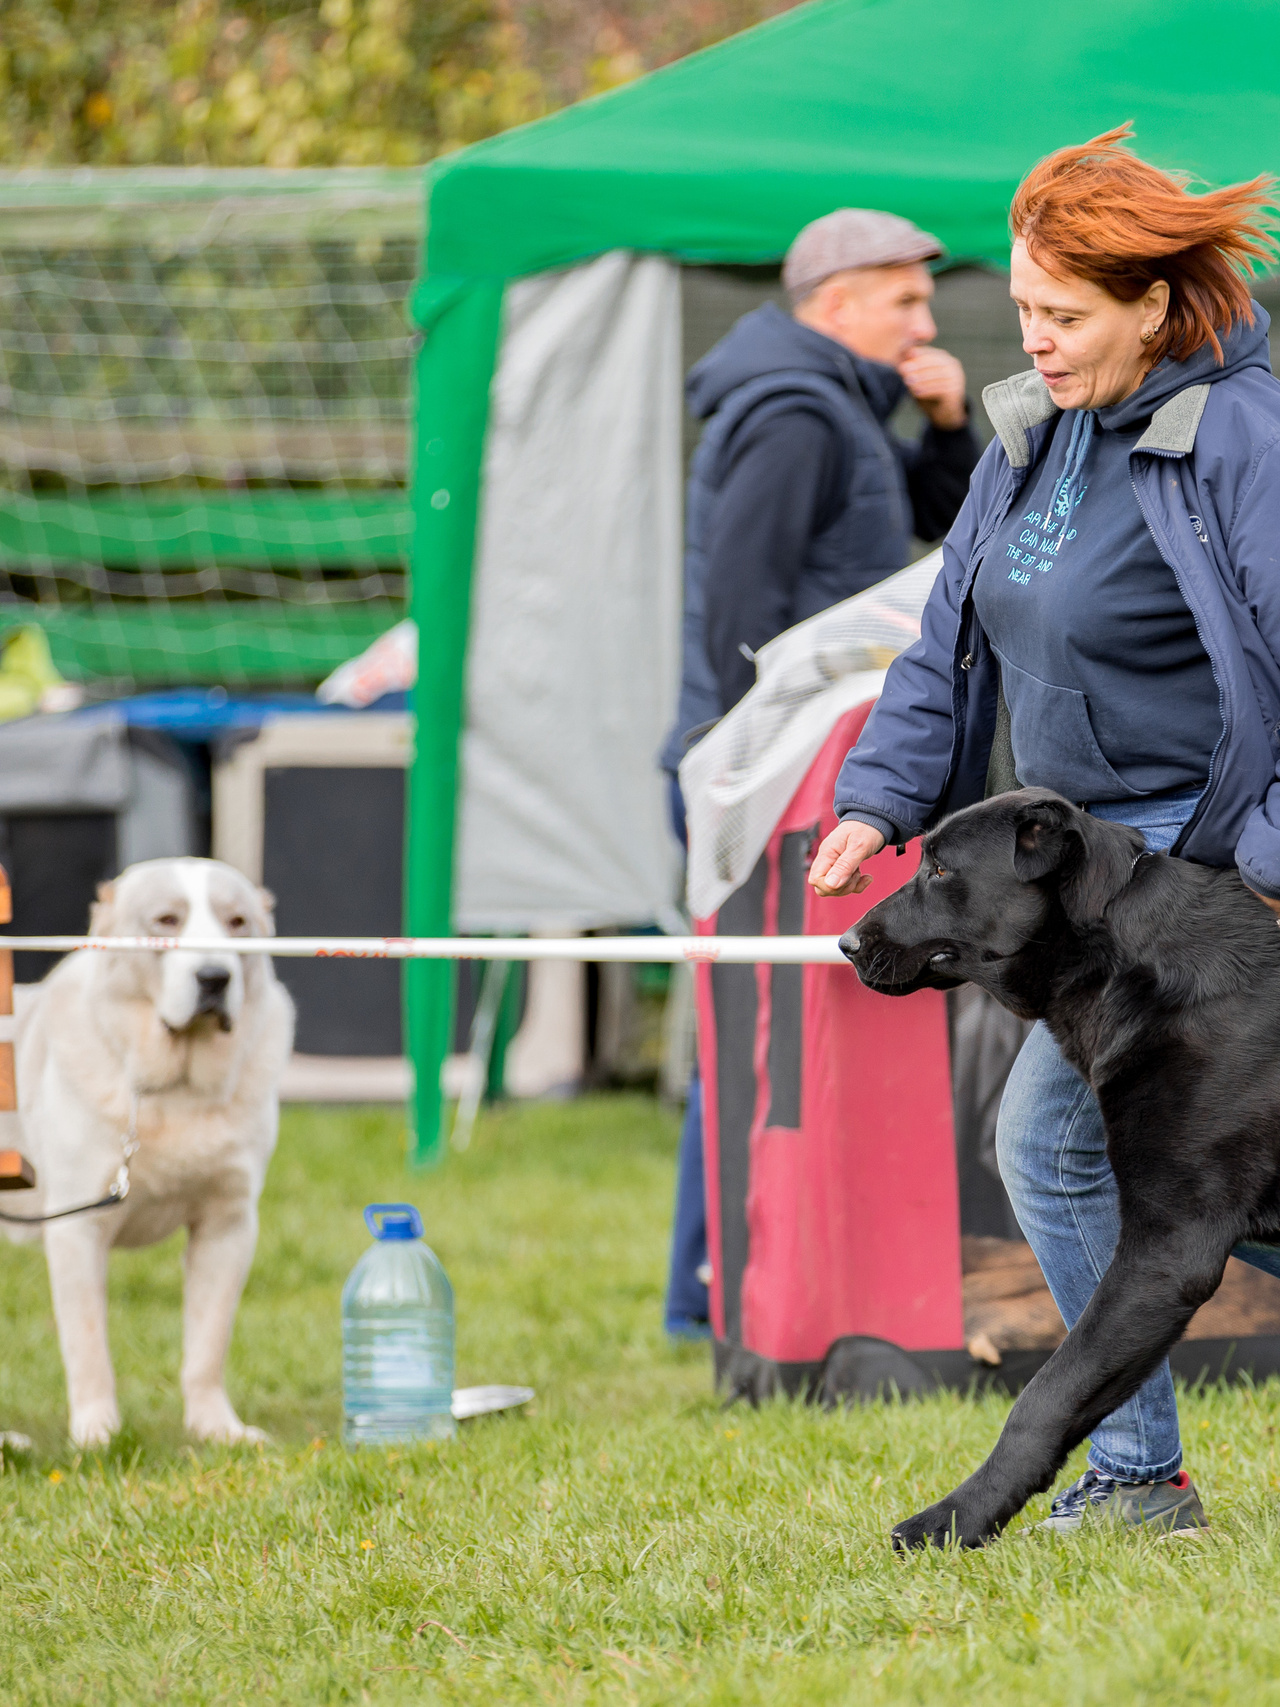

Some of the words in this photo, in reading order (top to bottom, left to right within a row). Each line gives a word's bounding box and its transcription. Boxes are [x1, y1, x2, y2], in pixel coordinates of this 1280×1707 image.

[1006, 543, 1023, 560] THE
[1035, 558, 1054, 573] AND
[1007, 566, 1032, 586] NEAR
